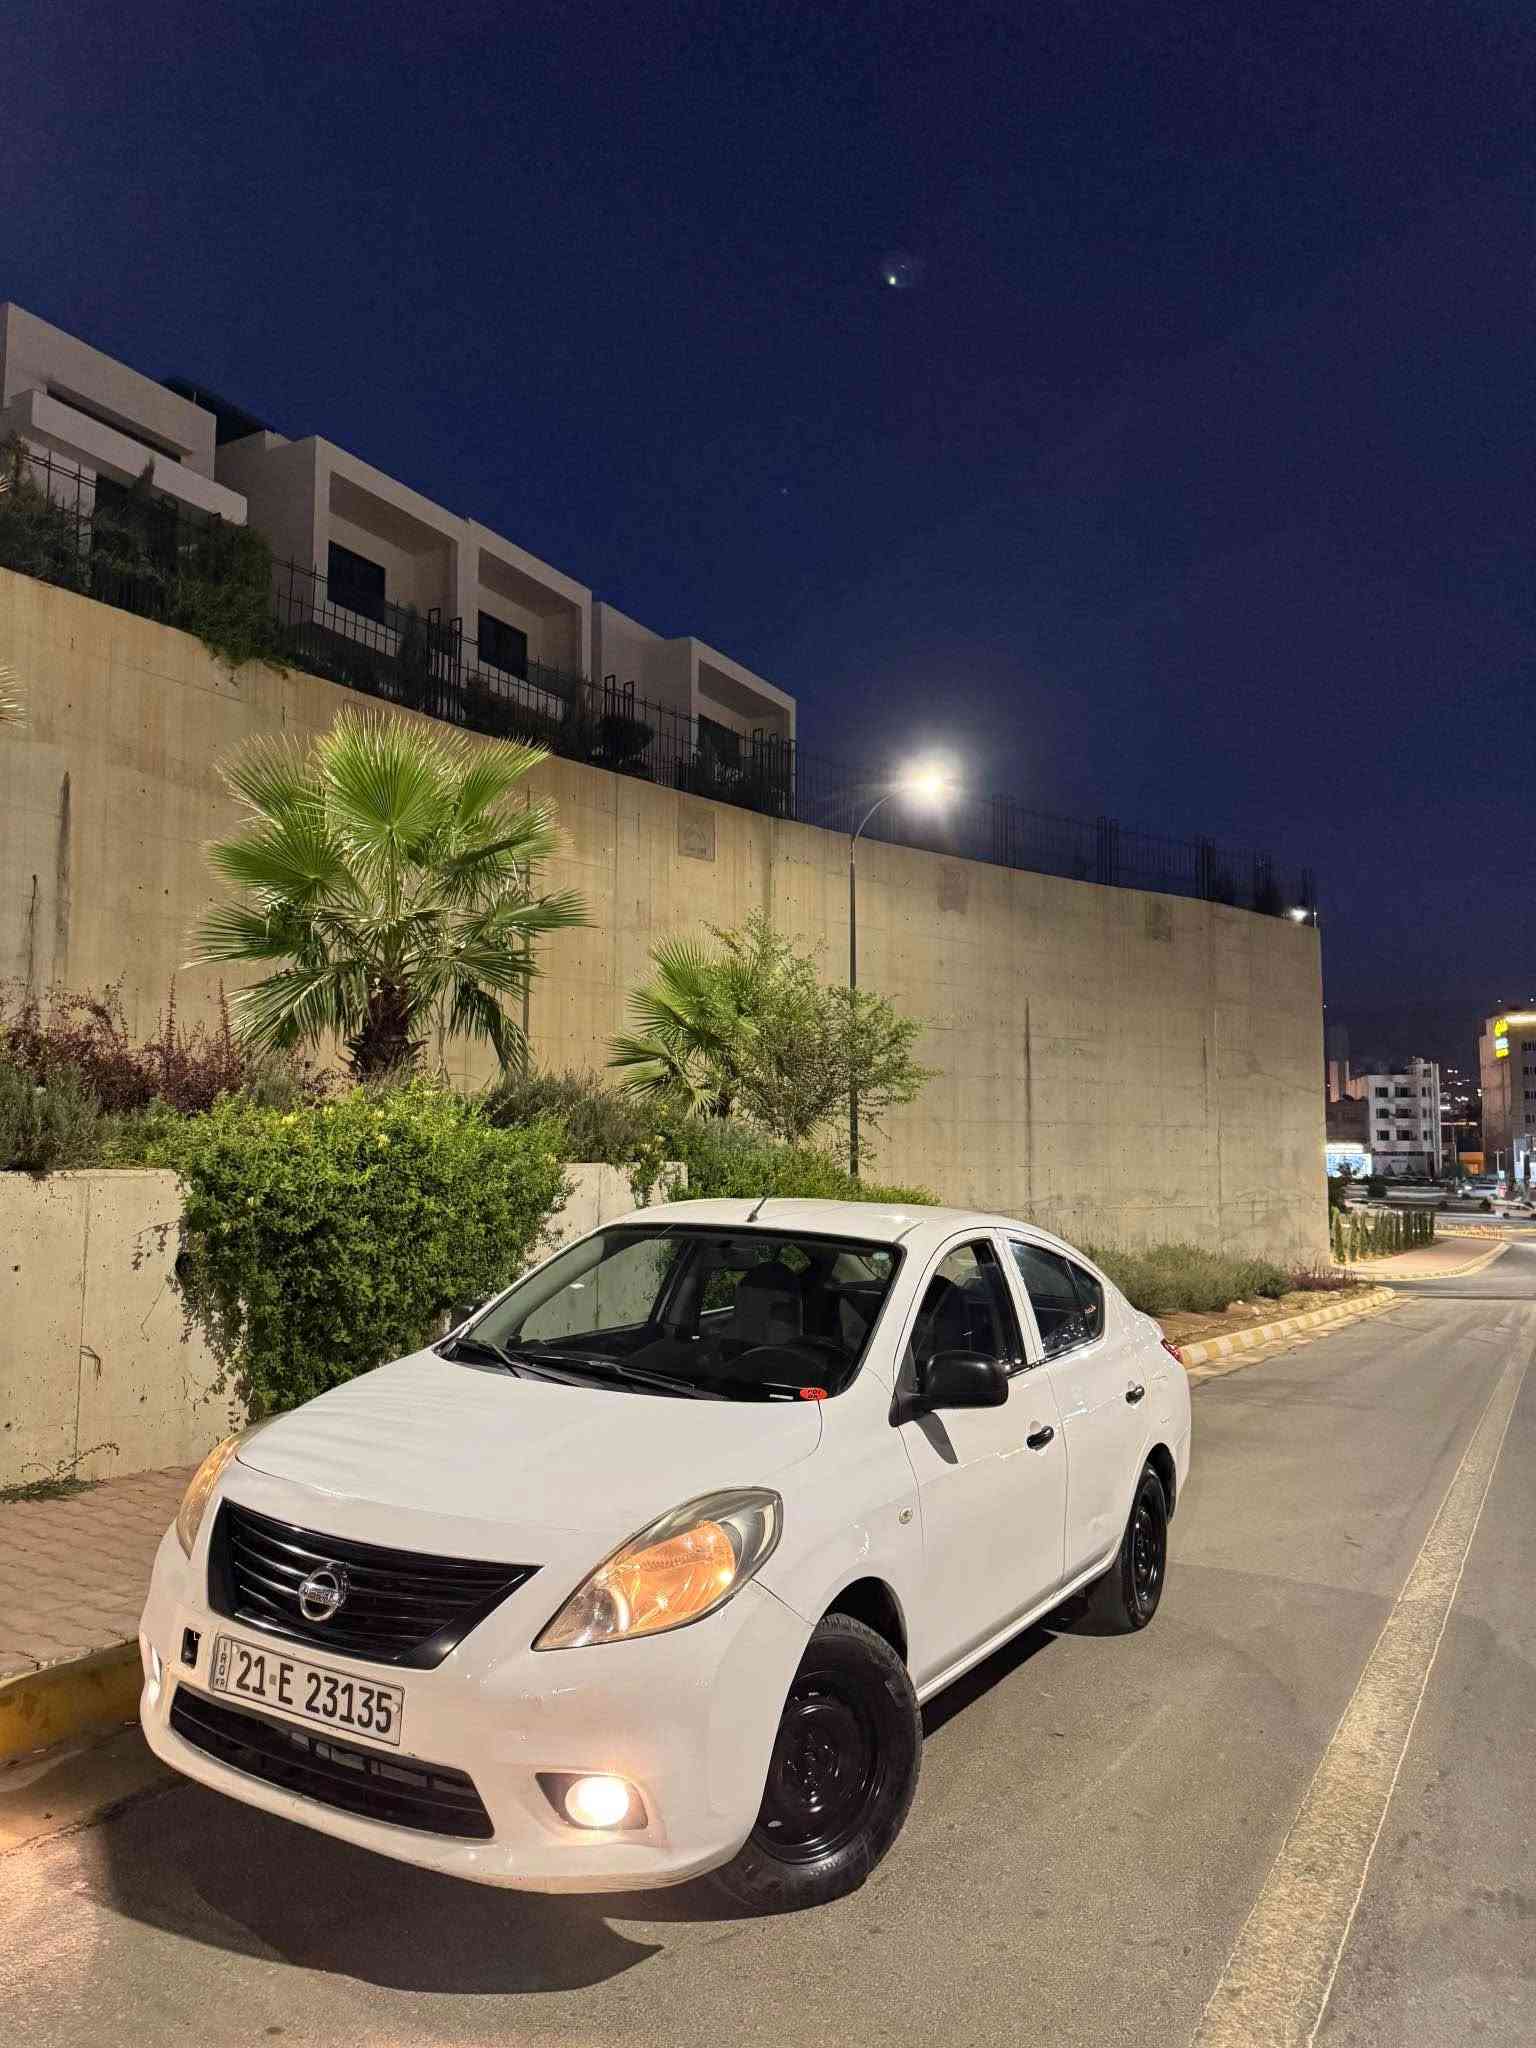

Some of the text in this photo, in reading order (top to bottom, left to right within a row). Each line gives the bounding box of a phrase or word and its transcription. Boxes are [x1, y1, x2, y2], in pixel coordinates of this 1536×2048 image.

[236, 1651, 392, 1733] 21 E 23135
